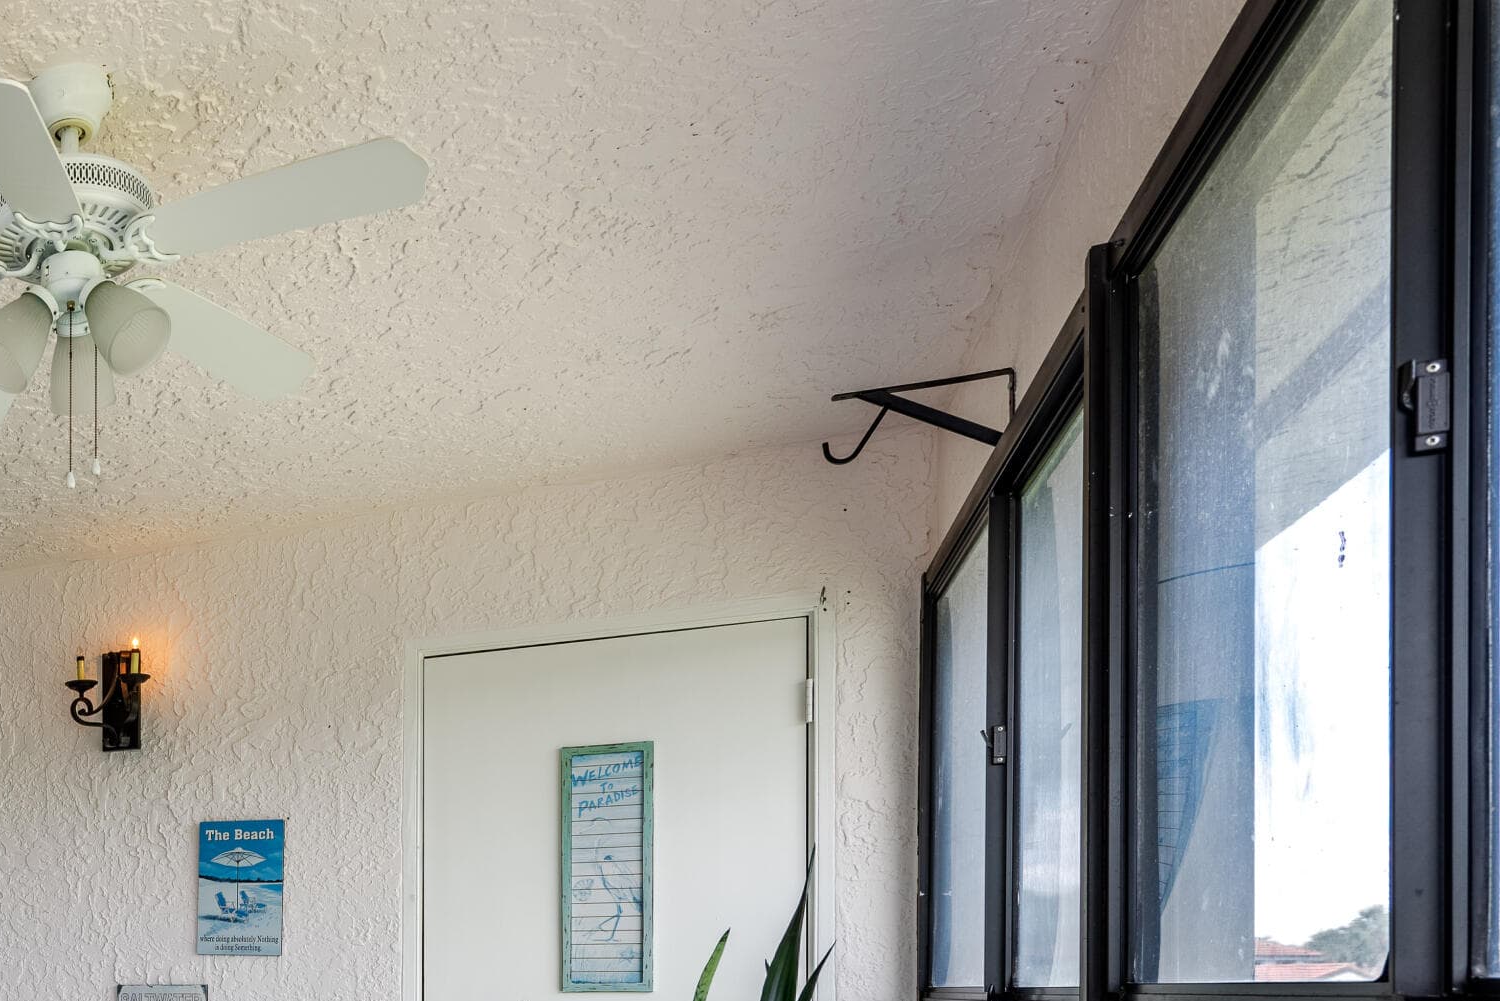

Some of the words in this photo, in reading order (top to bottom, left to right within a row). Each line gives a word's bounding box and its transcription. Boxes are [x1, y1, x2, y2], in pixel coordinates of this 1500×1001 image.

[205, 829, 230, 841] The
[234, 828, 275, 840] Beach
[200, 934, 215, 942] where
[231, 935, 256, 944] absolutely
[257, 935, 279, 944] Nothing
